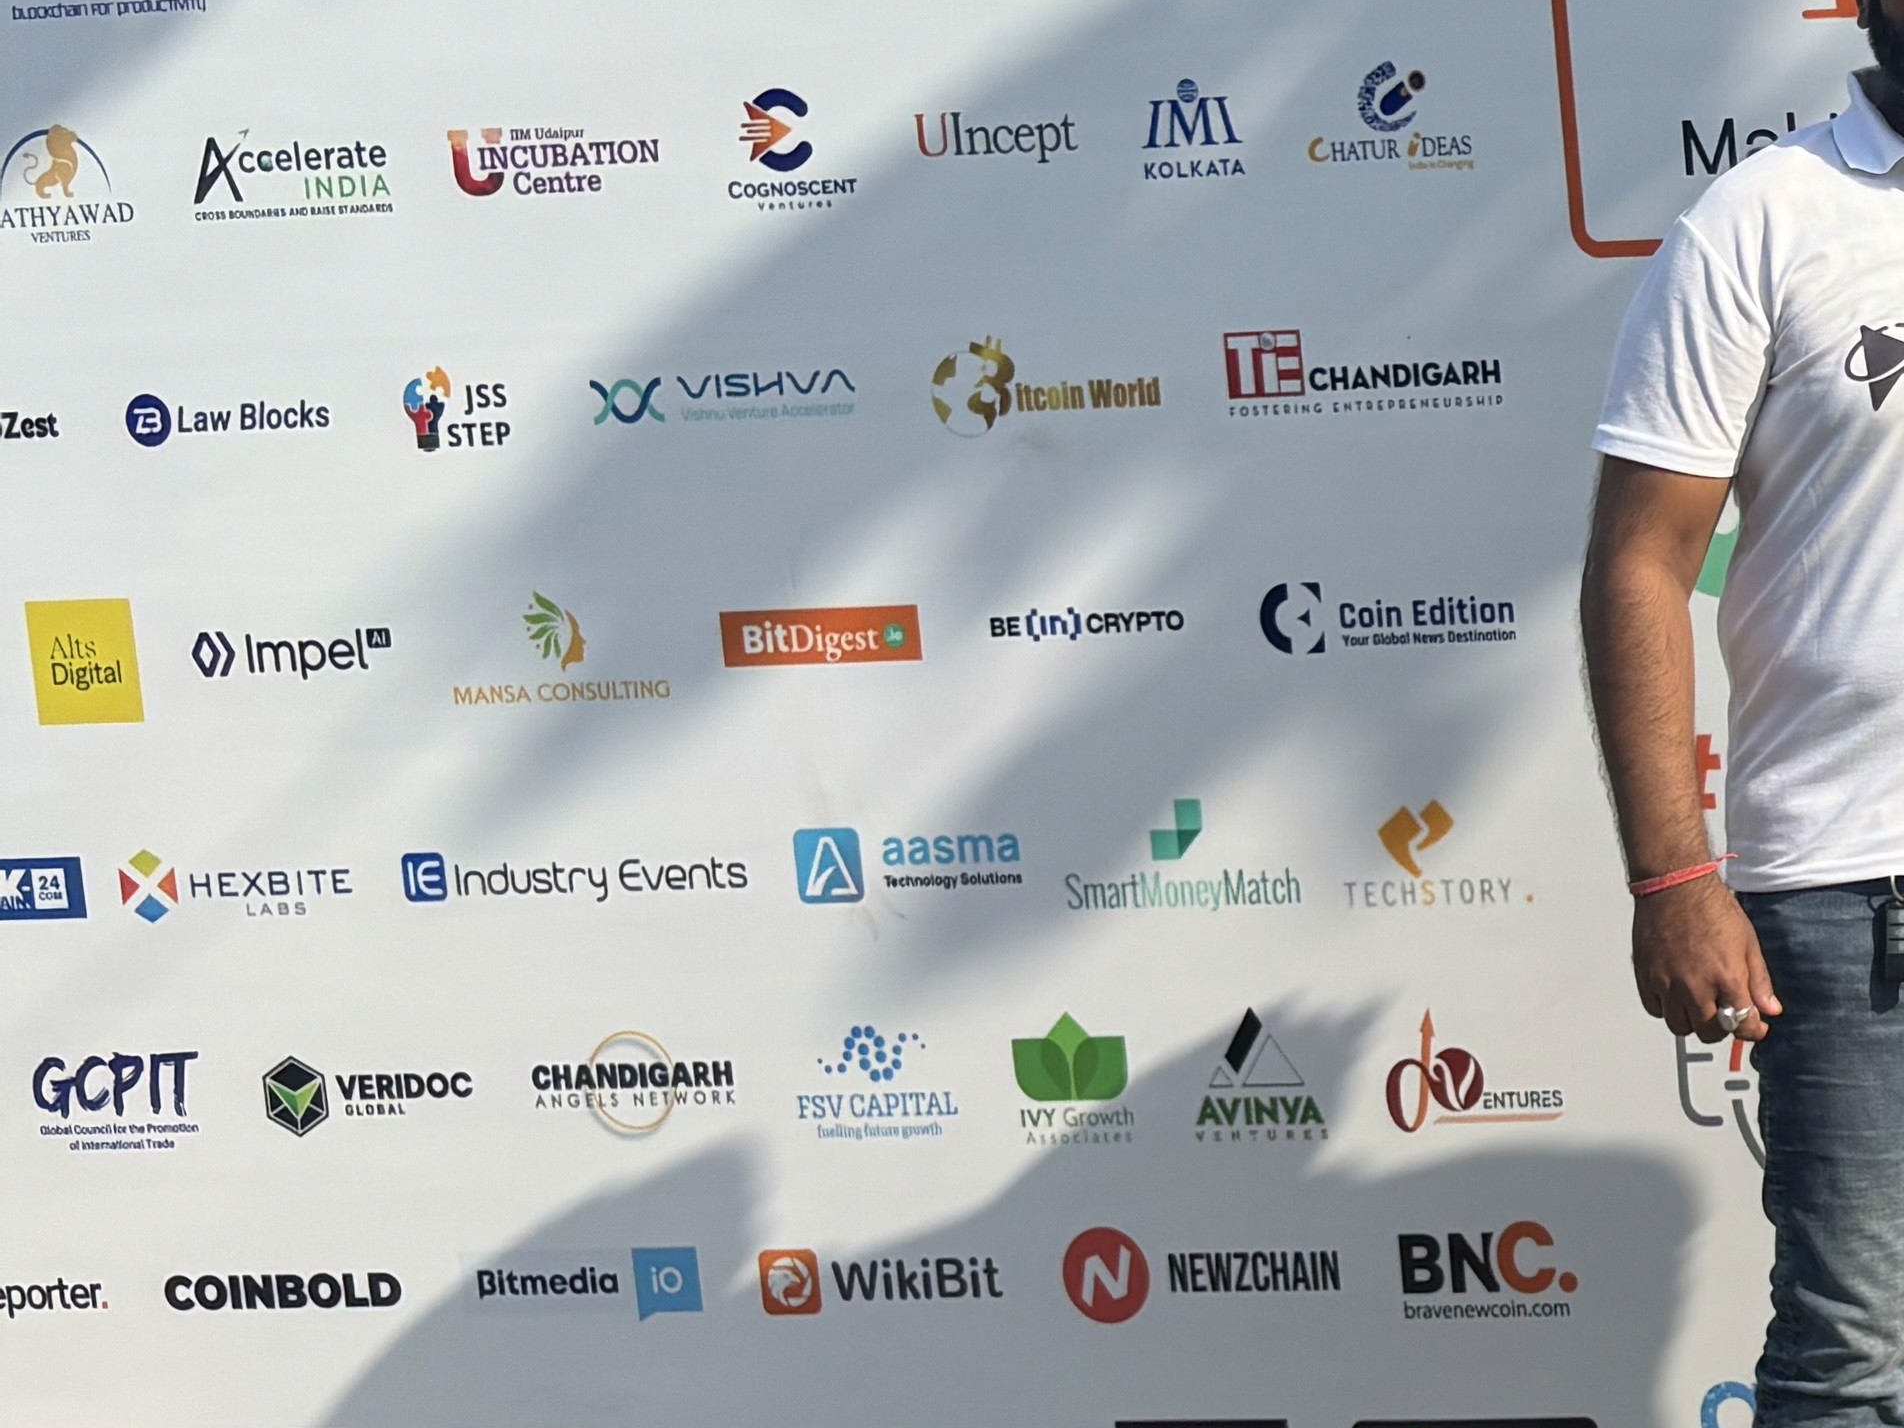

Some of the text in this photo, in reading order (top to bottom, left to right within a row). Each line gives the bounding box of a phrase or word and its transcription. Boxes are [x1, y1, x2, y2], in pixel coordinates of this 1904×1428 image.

[914, 113, 1078, 163] UIncept
[1308, 136, 1400, 164] CHATUR
[195, 129, 387, 204] Accelerate
[479, 139, 660, 170] INCUBATION
[1144, 158, 1245, 180] KOLKATA
[304, 175, 390, 200] INDIA
[512, 170, 602, 196] Centre
[728, 179, 857, 200] COGNOSCENT
[1308, 359, 1501, 393] CHANDIGARH
[464, 383, 507, 410] JSS
[1091, 376, 1161, 409] World
[178, 400, 330, 434] Law Blocks
[447, 421, 511, 448] STEP
[1338, 597, 1515, 630] Coin Edition
[49, 634, 96, 662] Alts
[246, 628, 368, 680] Impel
[742, 622, 879, 663] BitDigest
[51, 660, 122, 691] Digital
[453, 679, 671, 705] MANSA CONSULTING
[882, 831, 1021, 866] aasma
[189, 869, 353, 897] HEXBITE
[455, 856, 749, 902] Industry Events
[883, 872, 958, 890] Technology
[1065, 869, 1301, 911] SmartMoneyMatch
[246, 902, 307, 916] LABS
[32, 1051, 198, 1117] GCPIT
[336, 1072, 472, 1101] VERIDOC
[531, 1060, 733, 1091] CHANDIGARH
[535, 1089, 736, 1109] ANGELS NETWORK
[798, 1092, 957, 1120] FSV CAPITAL
[1197, 1095, 1323, 1127] AVINYA
[1019, 1106, 1134, 1129] IVY Growth
[477, 1267, 619, 1300] Bitmedia
[831, 1258, 1003, 1302] WikiBit
[1167, 1251, 1341, 1294] NEWZCHAIN
[164, 1272, 401, 1312] COINBOLD
[1403, 1300, 1570, 1321] bravenewcoin.com
